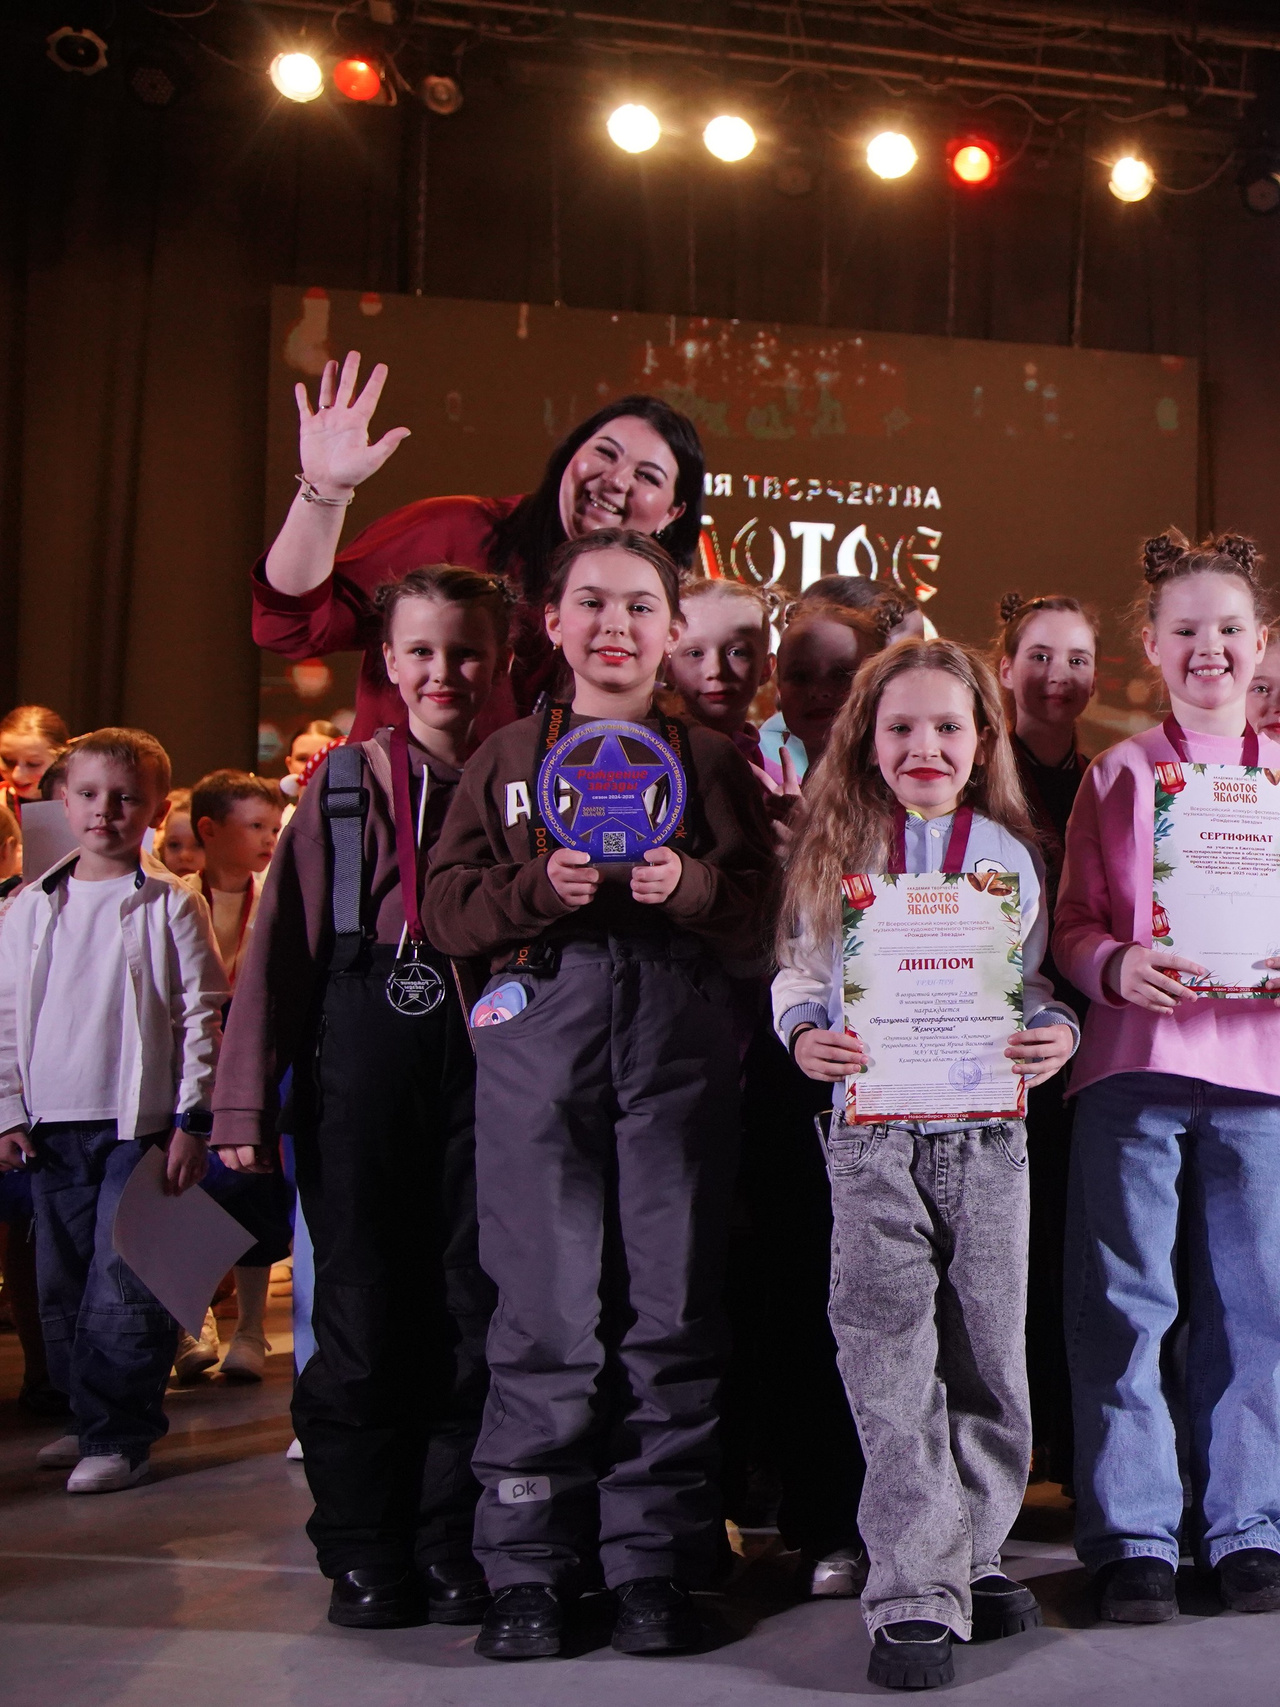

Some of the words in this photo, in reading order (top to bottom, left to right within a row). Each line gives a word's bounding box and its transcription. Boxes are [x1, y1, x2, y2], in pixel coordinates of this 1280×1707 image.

[577, 770, 648, 781] Рождение
[588, 782, 638, 792] звезды
[1213, 781, 1257, 793] ЗОЛОТОЕ
[1214, 792, 1257, 803] ЯБЛОЧКО
[652, 805, 682, 844] ТВОРЧЕСТВА
[1200, 832, 1273, 842] СЕРТИФИКАТ
[907, 892, 959, 903] ЗОЛОТОЕ
[908, 904, 959, 914] ЯБЛОЧКО
[898, 957, 974, 973] ДИПЛОМ
[869, 1016, 909, 1025] Образцовый
[910, 1015, 968, 1024] хореографический
